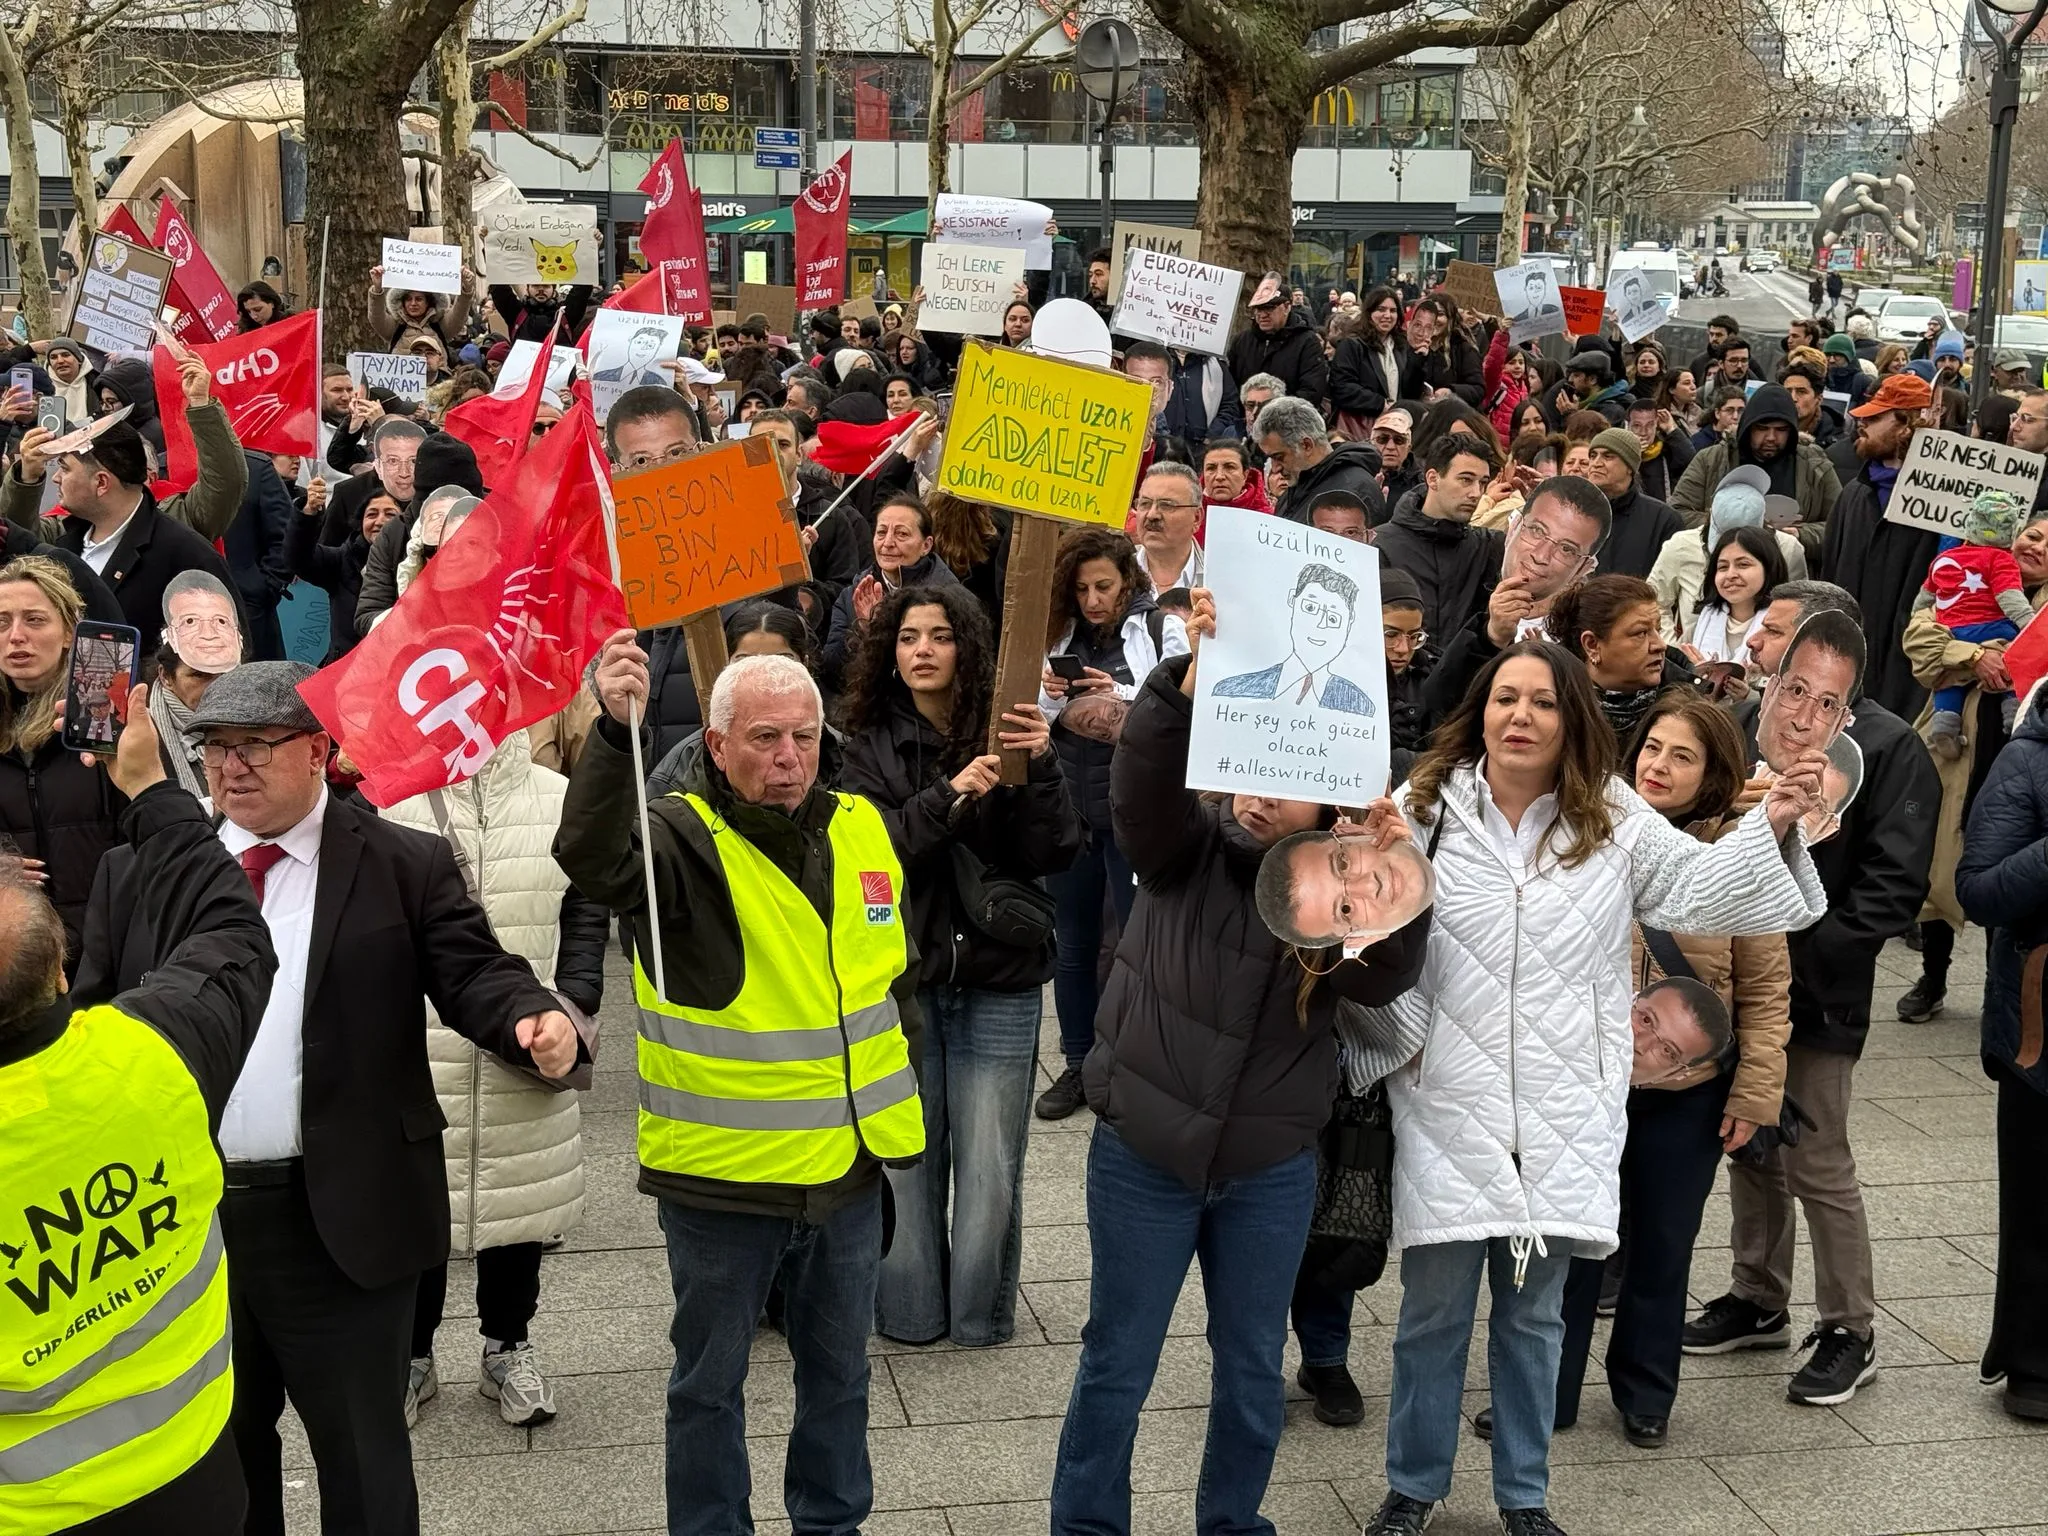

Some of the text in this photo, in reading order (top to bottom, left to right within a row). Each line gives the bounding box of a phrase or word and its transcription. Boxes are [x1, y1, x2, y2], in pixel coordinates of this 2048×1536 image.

[608, 89, 730, 112] McDnald's
[540, 215, 584, 237] Erdoğan
[942, 216, 1010, 228] RESISTANCE
[387, 243, 414, 255] ASLA
[1131, 269, 1217, 308] Verteidige
[1144, 254, 1225, 286] EUROPA!!!
[1123, 300, 1135, 311] in
[1146, 309, 1165, 320] der
[1125, 285, 1220, 323] deine WERTE
[969, 360, 1072, 420] Memleket
[961, 413, 1127, 488] ADALET
[1920, 435, 2039, 481] BİR NESİL DAHA
[947, 461, 1005, 494] daha
[1011, 476, 1040, 502] da
[1901, 494, 1949, 523] YOLU
[1256, 523, 1346, 565] üzülme
[1216, 703, 1377, 743] Her şey çok güzel
[1268, 738, 1329, 758] olacak
[1216, 756, 1363, 792] #alleswirdgut
[867, 907, 892, 922] CHP
[23, 1162, 139, 1254] NO
[4, 1195, 183, 1317] WAR
